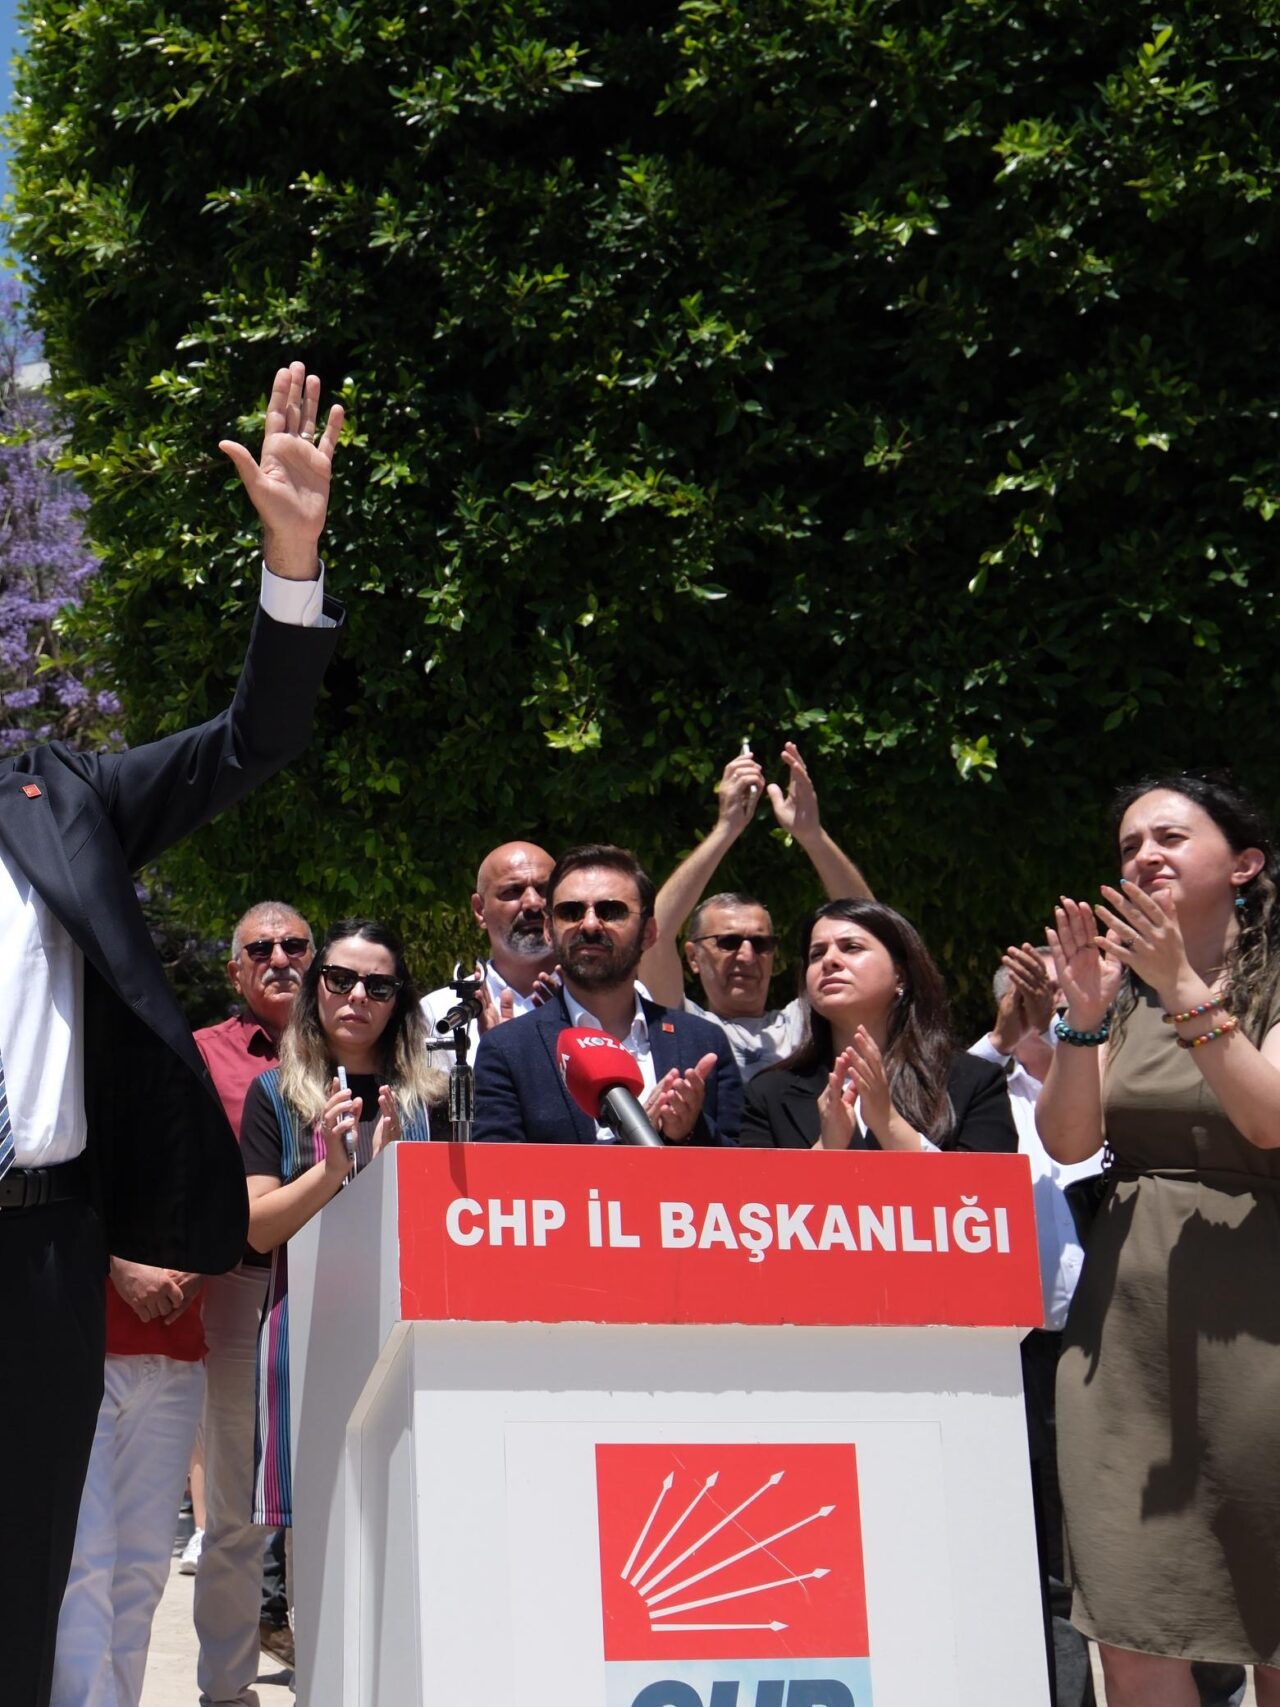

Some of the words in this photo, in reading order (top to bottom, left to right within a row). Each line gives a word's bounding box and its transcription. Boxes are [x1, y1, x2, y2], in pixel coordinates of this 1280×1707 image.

[445, 1197, 566, 1247] CHP
[587, 1188, 641, 1248] İL
[659, 1195, 1011, 1263] BAŞKANLIĞI
